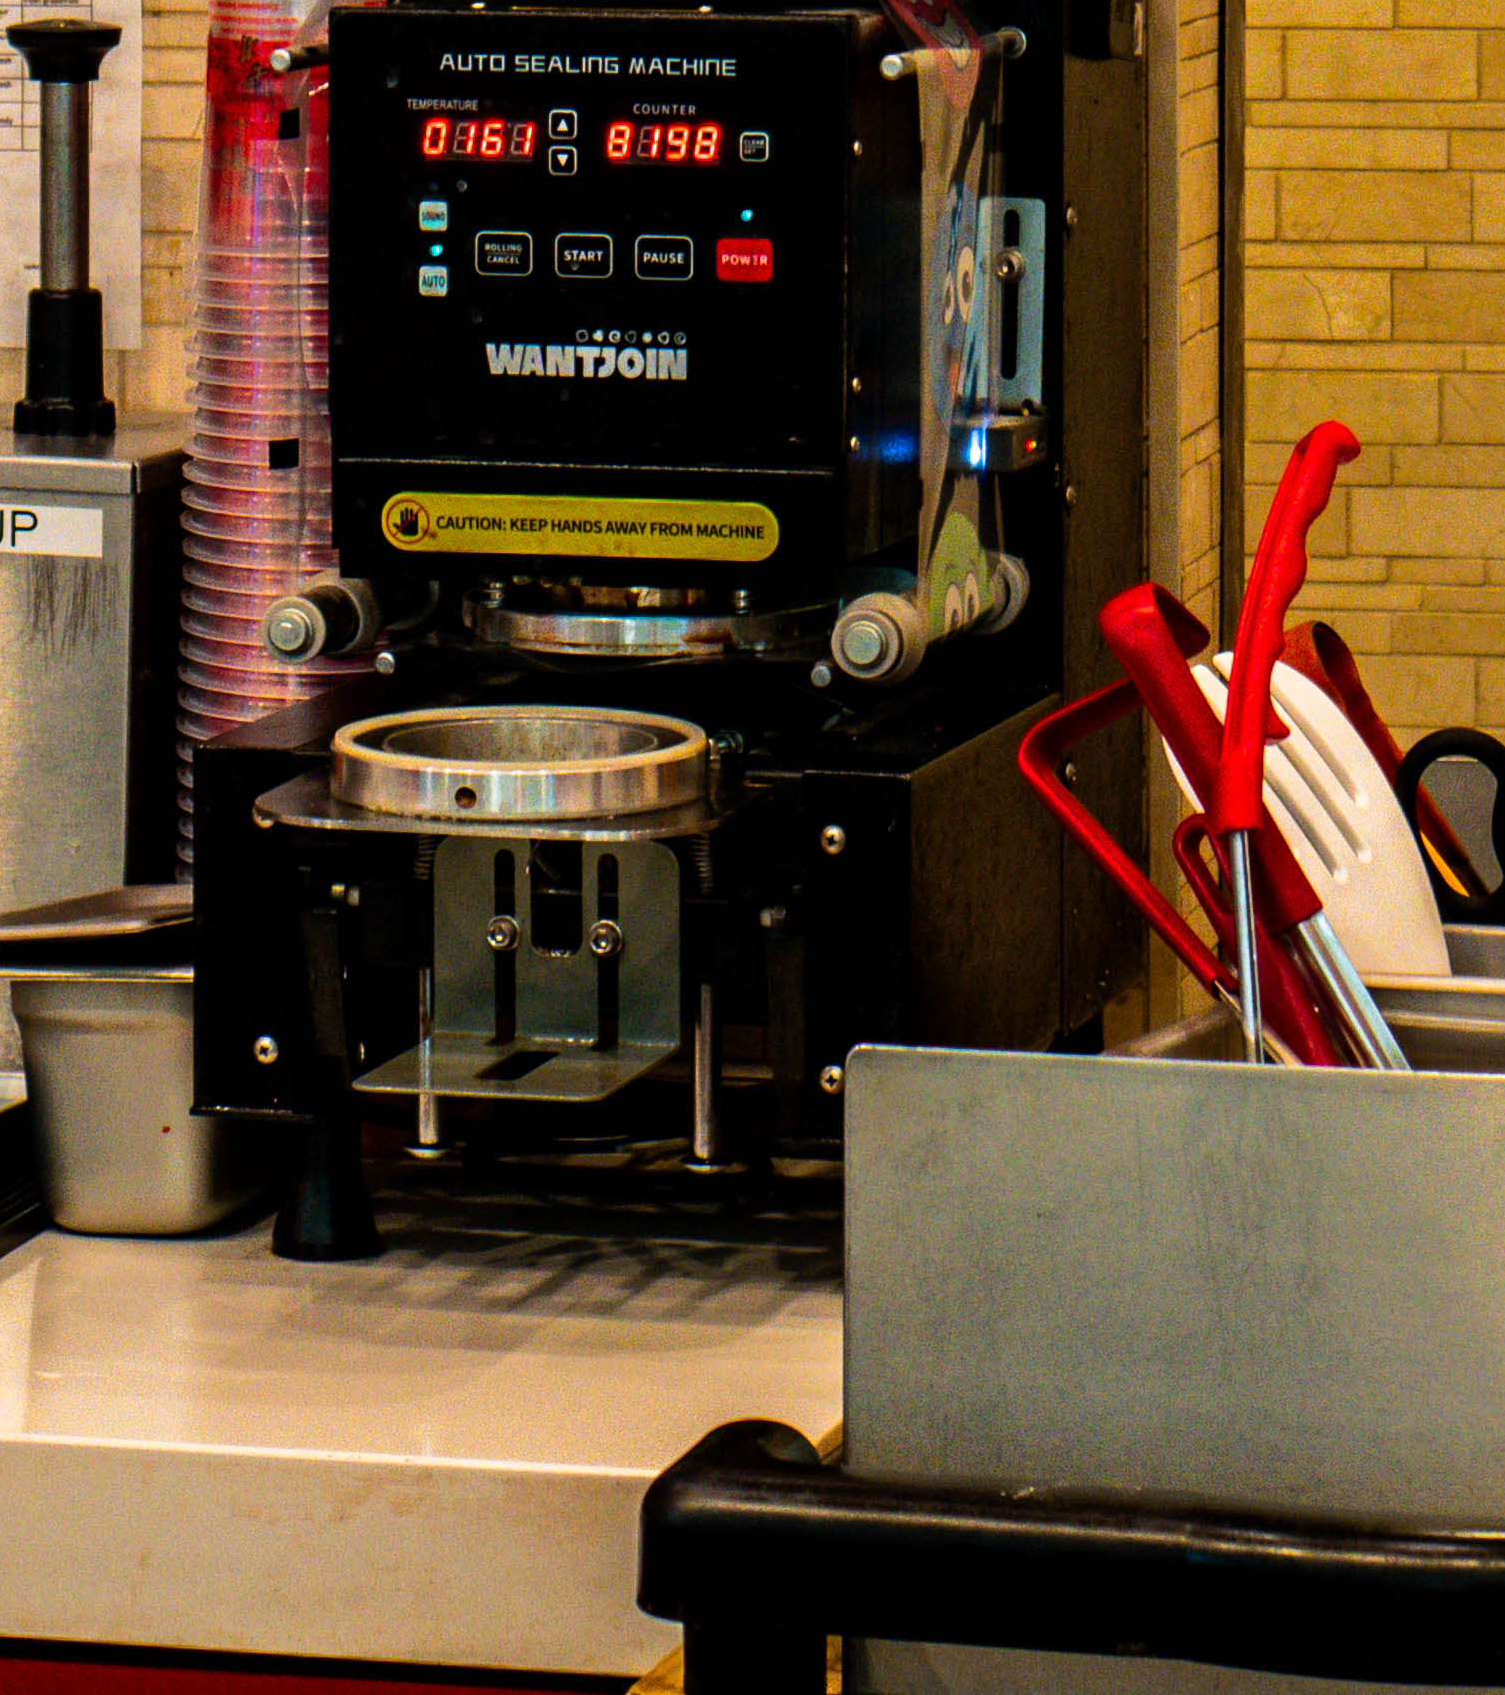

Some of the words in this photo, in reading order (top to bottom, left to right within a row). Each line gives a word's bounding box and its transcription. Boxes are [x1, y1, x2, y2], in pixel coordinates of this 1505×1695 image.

[439, 53, 506, 72] AUTO
[514, 55, 620, 74] SEALING
[628, 57, 737, 77] MACHINE
[407, 98, 479, 112] TEMPERATURE
[633, 103, 697, 116] COUNTER
[422, 119, 536, 158] 0161
[606, 122, 721, 161] 8198
[486, 255, 521, 265] CANCEL
[563, 249, 604, 262] START
[643, 251, 685, 264] PAUSE
[721, 254, 769, 266] POWER
[421, 275, 446, 288] AUTO
[485, 342, 688, 380] WANTJOIN
[435, 514, 507, 532] CAUTION:
[509, 517, 548, 532] KEEP
[550, 518, 603, 534] HANDS
[605, 520, 647, 536] AWAY
[649, 522, 694, 537] FROM
[696, 523, 765, 540] MACHINE
